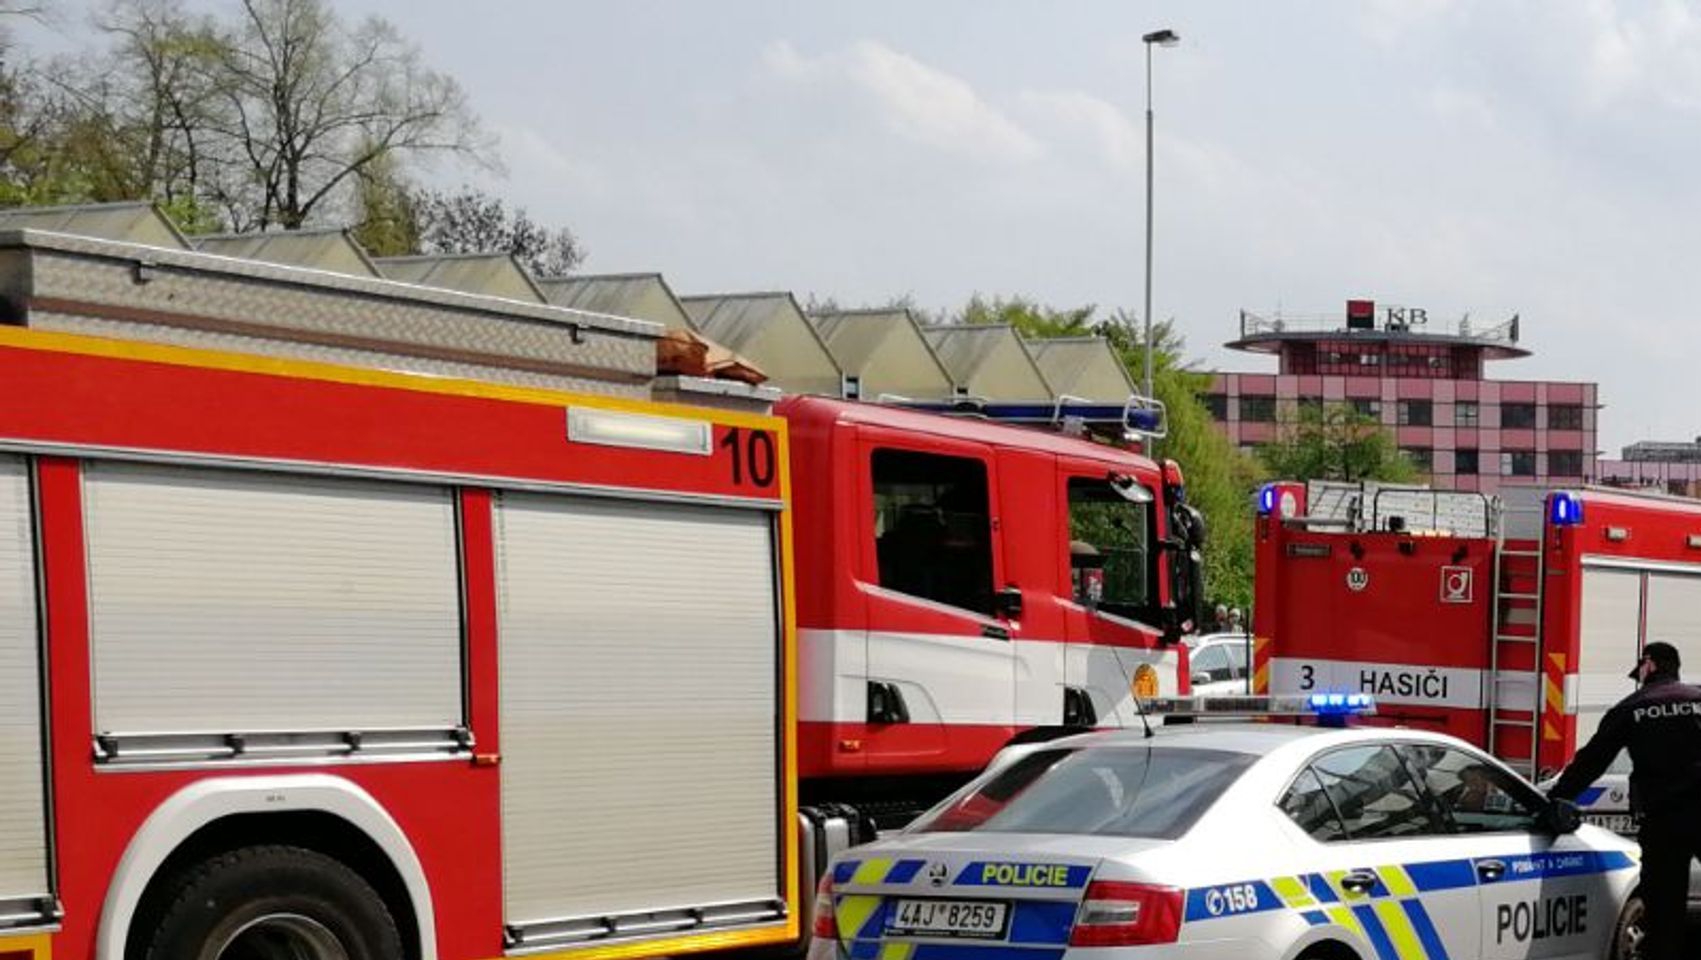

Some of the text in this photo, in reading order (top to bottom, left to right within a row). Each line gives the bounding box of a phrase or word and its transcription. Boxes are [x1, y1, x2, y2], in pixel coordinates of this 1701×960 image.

[1386, 307, 1429, 325] KB
[721, 427, 776, 489] 10
[1300, 665, 1316, 691] 3
[1359, 668, 1449, 699] HASIČI
[982, 864, 1068, 887] POLICIE
[1223, 885, 1258, 911] 158
[899, 901, 997, 929] 4AJ 8259
[1496, 895, 1588, 945] POLICIE
